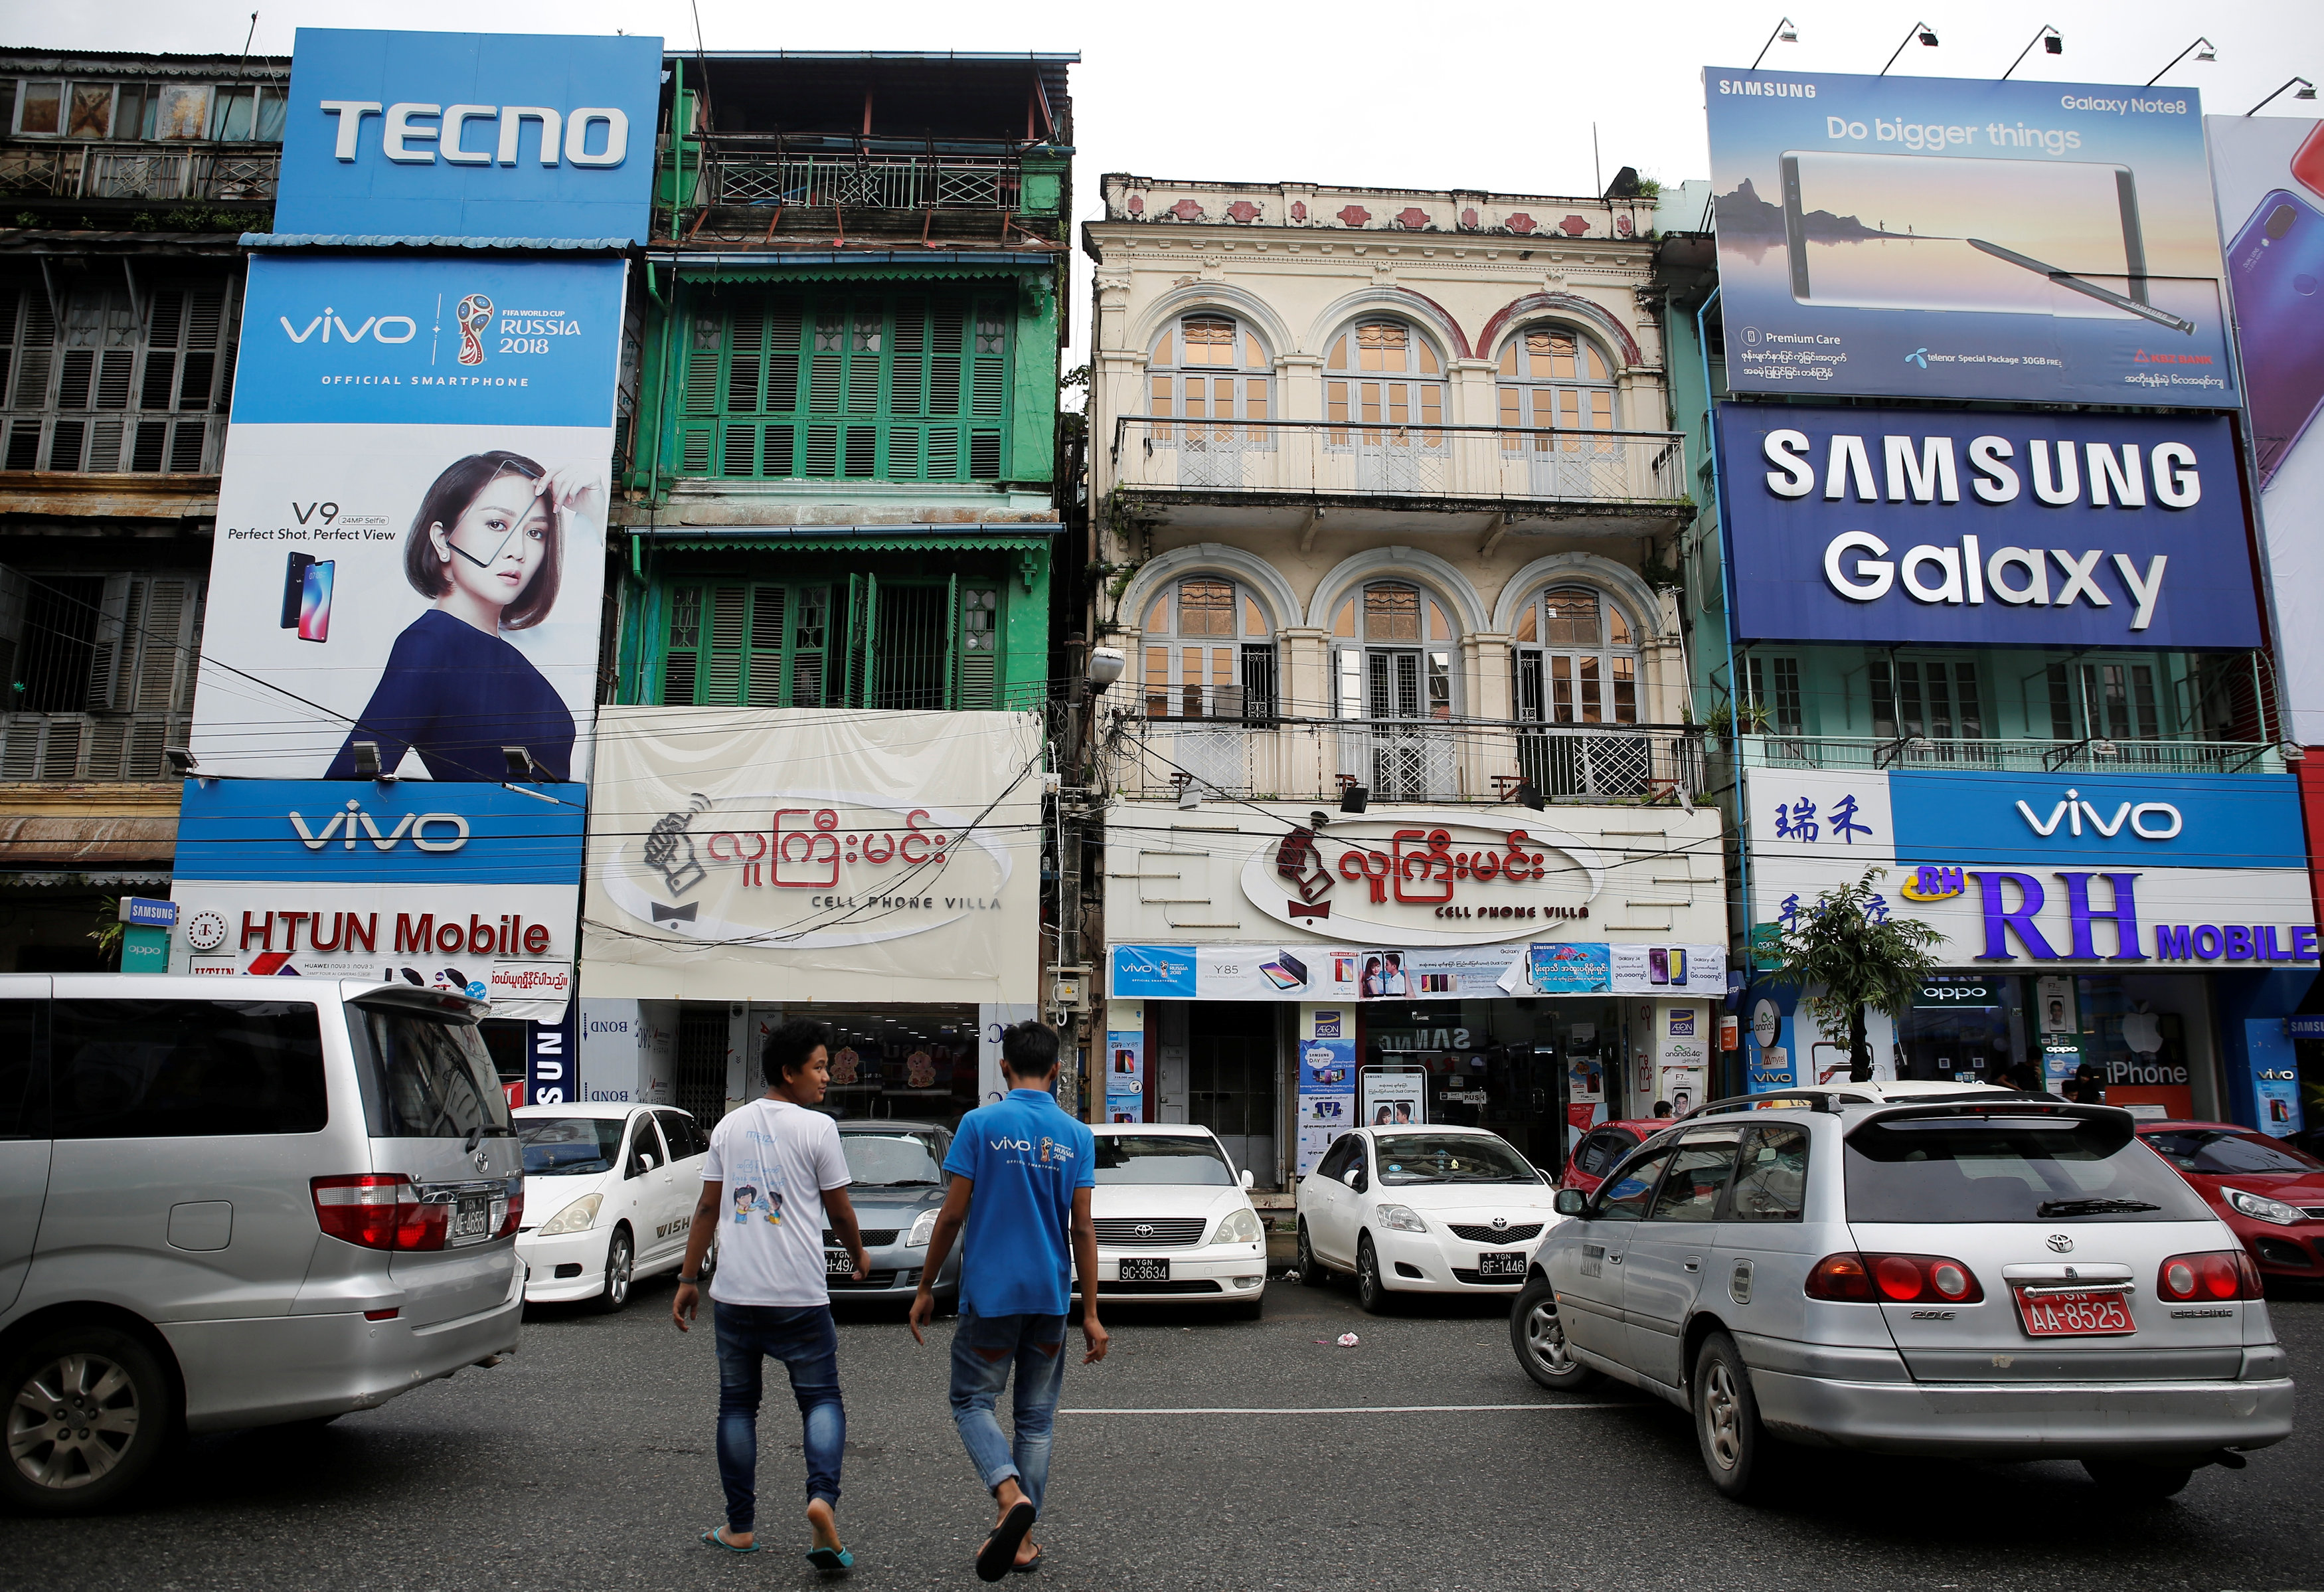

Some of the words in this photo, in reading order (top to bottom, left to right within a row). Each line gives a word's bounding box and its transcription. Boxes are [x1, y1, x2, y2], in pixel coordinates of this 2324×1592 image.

[1718, 79, 1816, 99] SAMSUNG
[2060, 94, 2127, 115] Galaxy
[2131, 96, 2187, 115] Note8
[320, 100, 628, 167] TECNO
[1827, 116, 1867, 139] Do
[1876, 117, 1977, 151] bigger
[1986, 121, 2082, 155] things
[2129, 302, 2169, 319] SAMSUNG
[280, 306, 416, 343] vivo
[501, 319, 581, 335] RUSSIA
[499, 337, 549, 354] 2018
[1766, 333, 1814, 344] Premium
[1817, 334, 1841, 345] Care
[1958, 355, 1986, 363] Special
[1987, 356, 2019, 365] Package
[2150, 354, 2177, 363] KBZ
[2178, 355, 2213, 364] BANK
[321, 375, 401, 385] OFFICIAL
[411, 375, 529, 387] SMARTPHONE
[1762, 429, 2201, 509] SAMSUNG
[292, 502, 339, 525] V9
[228, 528, 274, 540] Perfect
[278, 529, 310, 541] Shot,
[313, 529, 359, 540] Perfect
[364, 531, 396, 541] View
[1822, 531, 2167, 632] Galaxy
[1775, 794, 1873, 844] 瑞禾
[2015, 788, 2183, 840] vivo
[289, 799, 469, 851] vivo
[1339, 830, 1545, 904] လူကြီးမင်း
[1917, 866, 1965, 895] RH
[812, 896, 855, 909] CELL
[869, 897, 932, 909] PHONE
[945, 897, 1001, 910] VILLA
[133, 905, 173, 919] SAMSUNG
[1434, 906, 1473, 919] CELL
[1477, 906, 1537, 919] PHONE
[1542, 906, 1590, 919] VILLA
[1969, 871, 2151, 960] RH
[238, 911, 378, 951] HTUN
[395, 913, 551, 954] Mobile
[128, 945, 161, 955] oppo
[2155, 925, 2317, 961] MOBILE
[1121, 962, 1151, 973] vivo
[1214, 965, 1238, 974] Y85
[1535, 962, 1558, 975] မိုးရာသီ
[1923, 988, 1987, 1000] oppo
[591, 1021, 628, 1032] BOND
[1755, 1021, 1774, 1031] ananda
[537, 1019, 563, 1104] SUN
[1771, 1054, 1785, 1065] mytel
[1754, 1071, 1791, 1083] vivo
[1820, 1073, 1830, 1083] NEW
[2106, 1061, 2188, 1083] iPhone
[2257, 1068, 2294, 1080] vivo
[592, 1091, 628, 1101] BOND
[990, 1136, 1031, 1151] vivo
[1053, 1153, 1066, 1162] 2018
[1054, 1147, 1074, 1158] RUSSIA
[465, 1200, 475, 1210] YGN
[456, 1211, 484, 1235] 4E-4655
[656, 1217, 691, 1239] WISH
[1121, 1267, 1167, 1279] 9C-3634
[1482, 1261, 1524, 1273] 6F-1446
[2031, 1301, 2125, 1331] AA-8525
